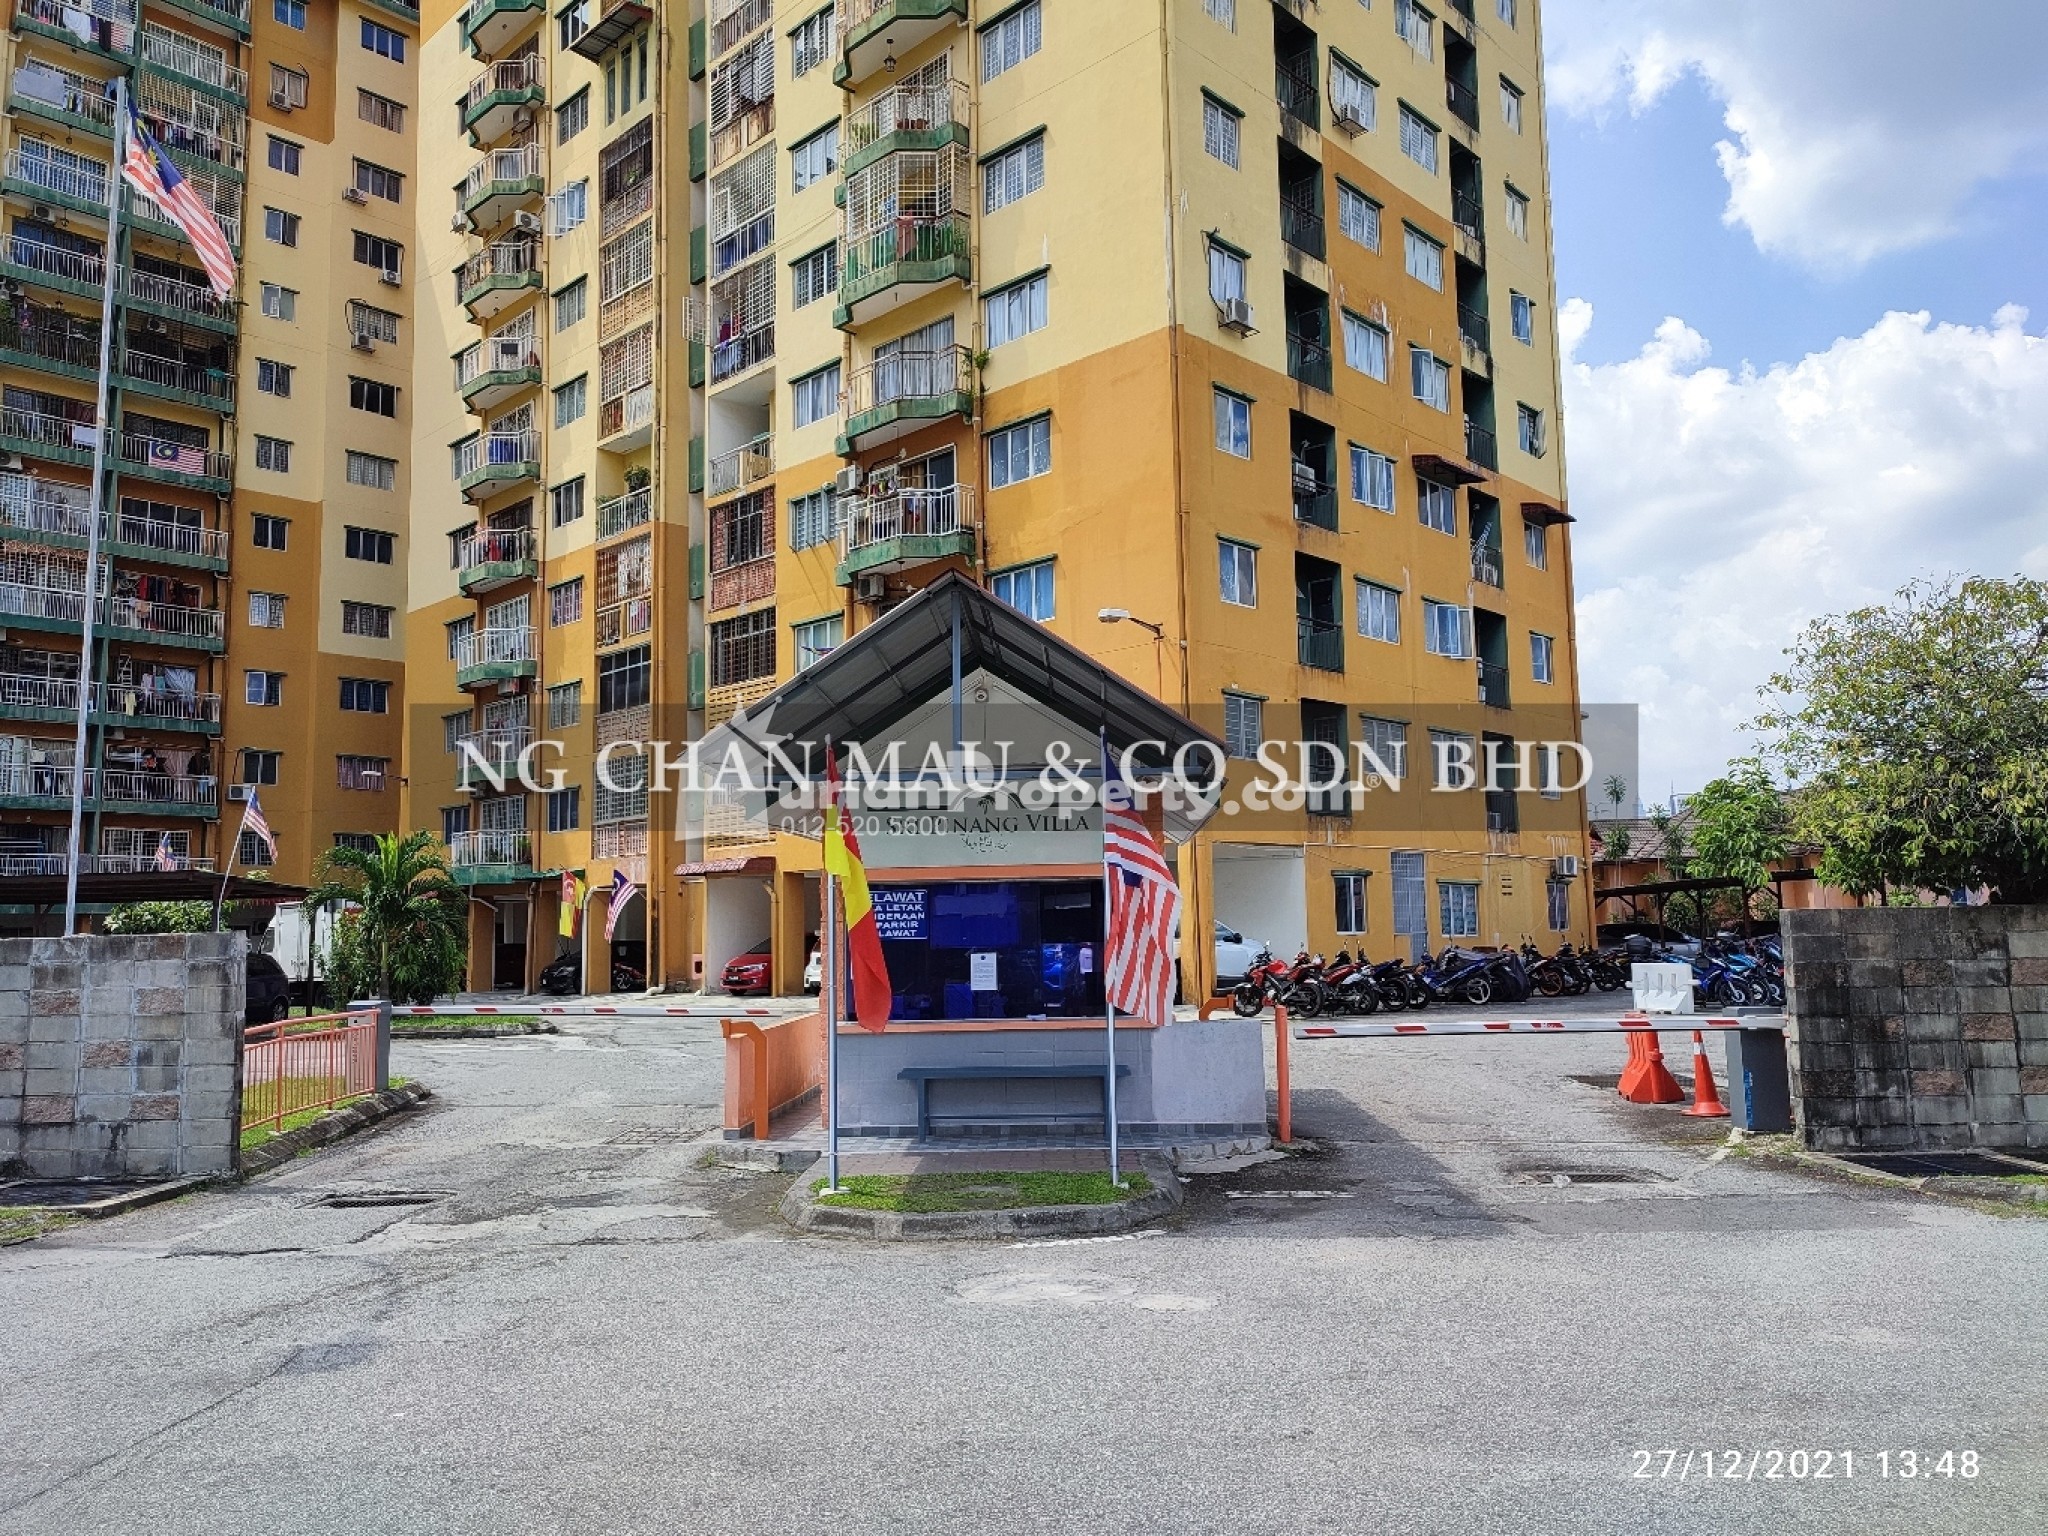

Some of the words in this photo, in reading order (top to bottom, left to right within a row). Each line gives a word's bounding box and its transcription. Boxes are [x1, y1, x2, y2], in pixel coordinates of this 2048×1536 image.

[929, 815, 1019, 834] PNANG
[1025, 813, 1090, 832] VILLA
[868, 891, 925, 903] ELAWAT
[886, 904, 924, 912] LETAK
[874, 911, 925, 920] DERAAN
[876, 920, 919, 929] PARKIR
[878, 929, 918, 937] LAWAT
